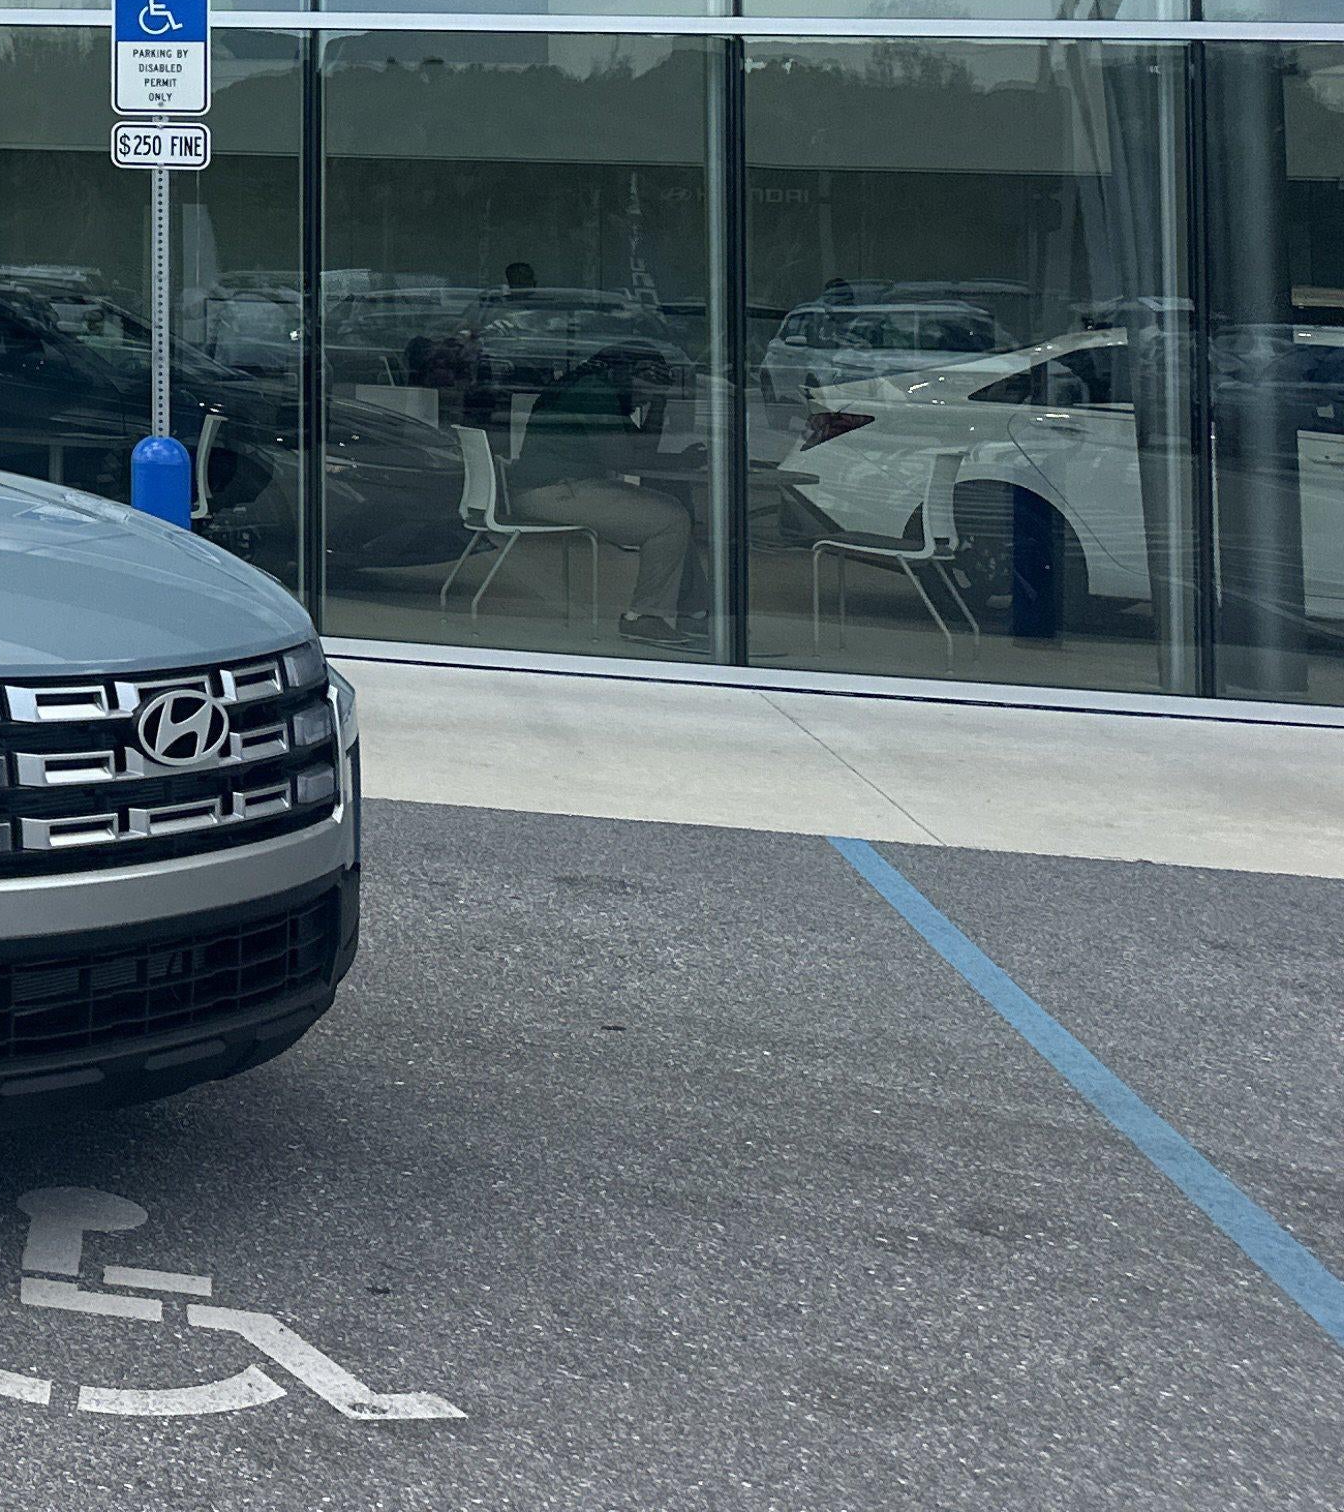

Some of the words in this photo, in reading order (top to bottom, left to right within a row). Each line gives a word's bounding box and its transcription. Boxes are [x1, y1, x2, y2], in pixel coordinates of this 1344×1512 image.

[132, 48, 173, 59] PARKING
[176, 48, 189, 59] BY
[138, 63, 183, 73] DISABLED
[144, 78, 177, 88] PERMIT
[148, 92, 173, 102] ONLY
[119, 133, 162, 157] $250
[170, 135, 203, 157] FINE
